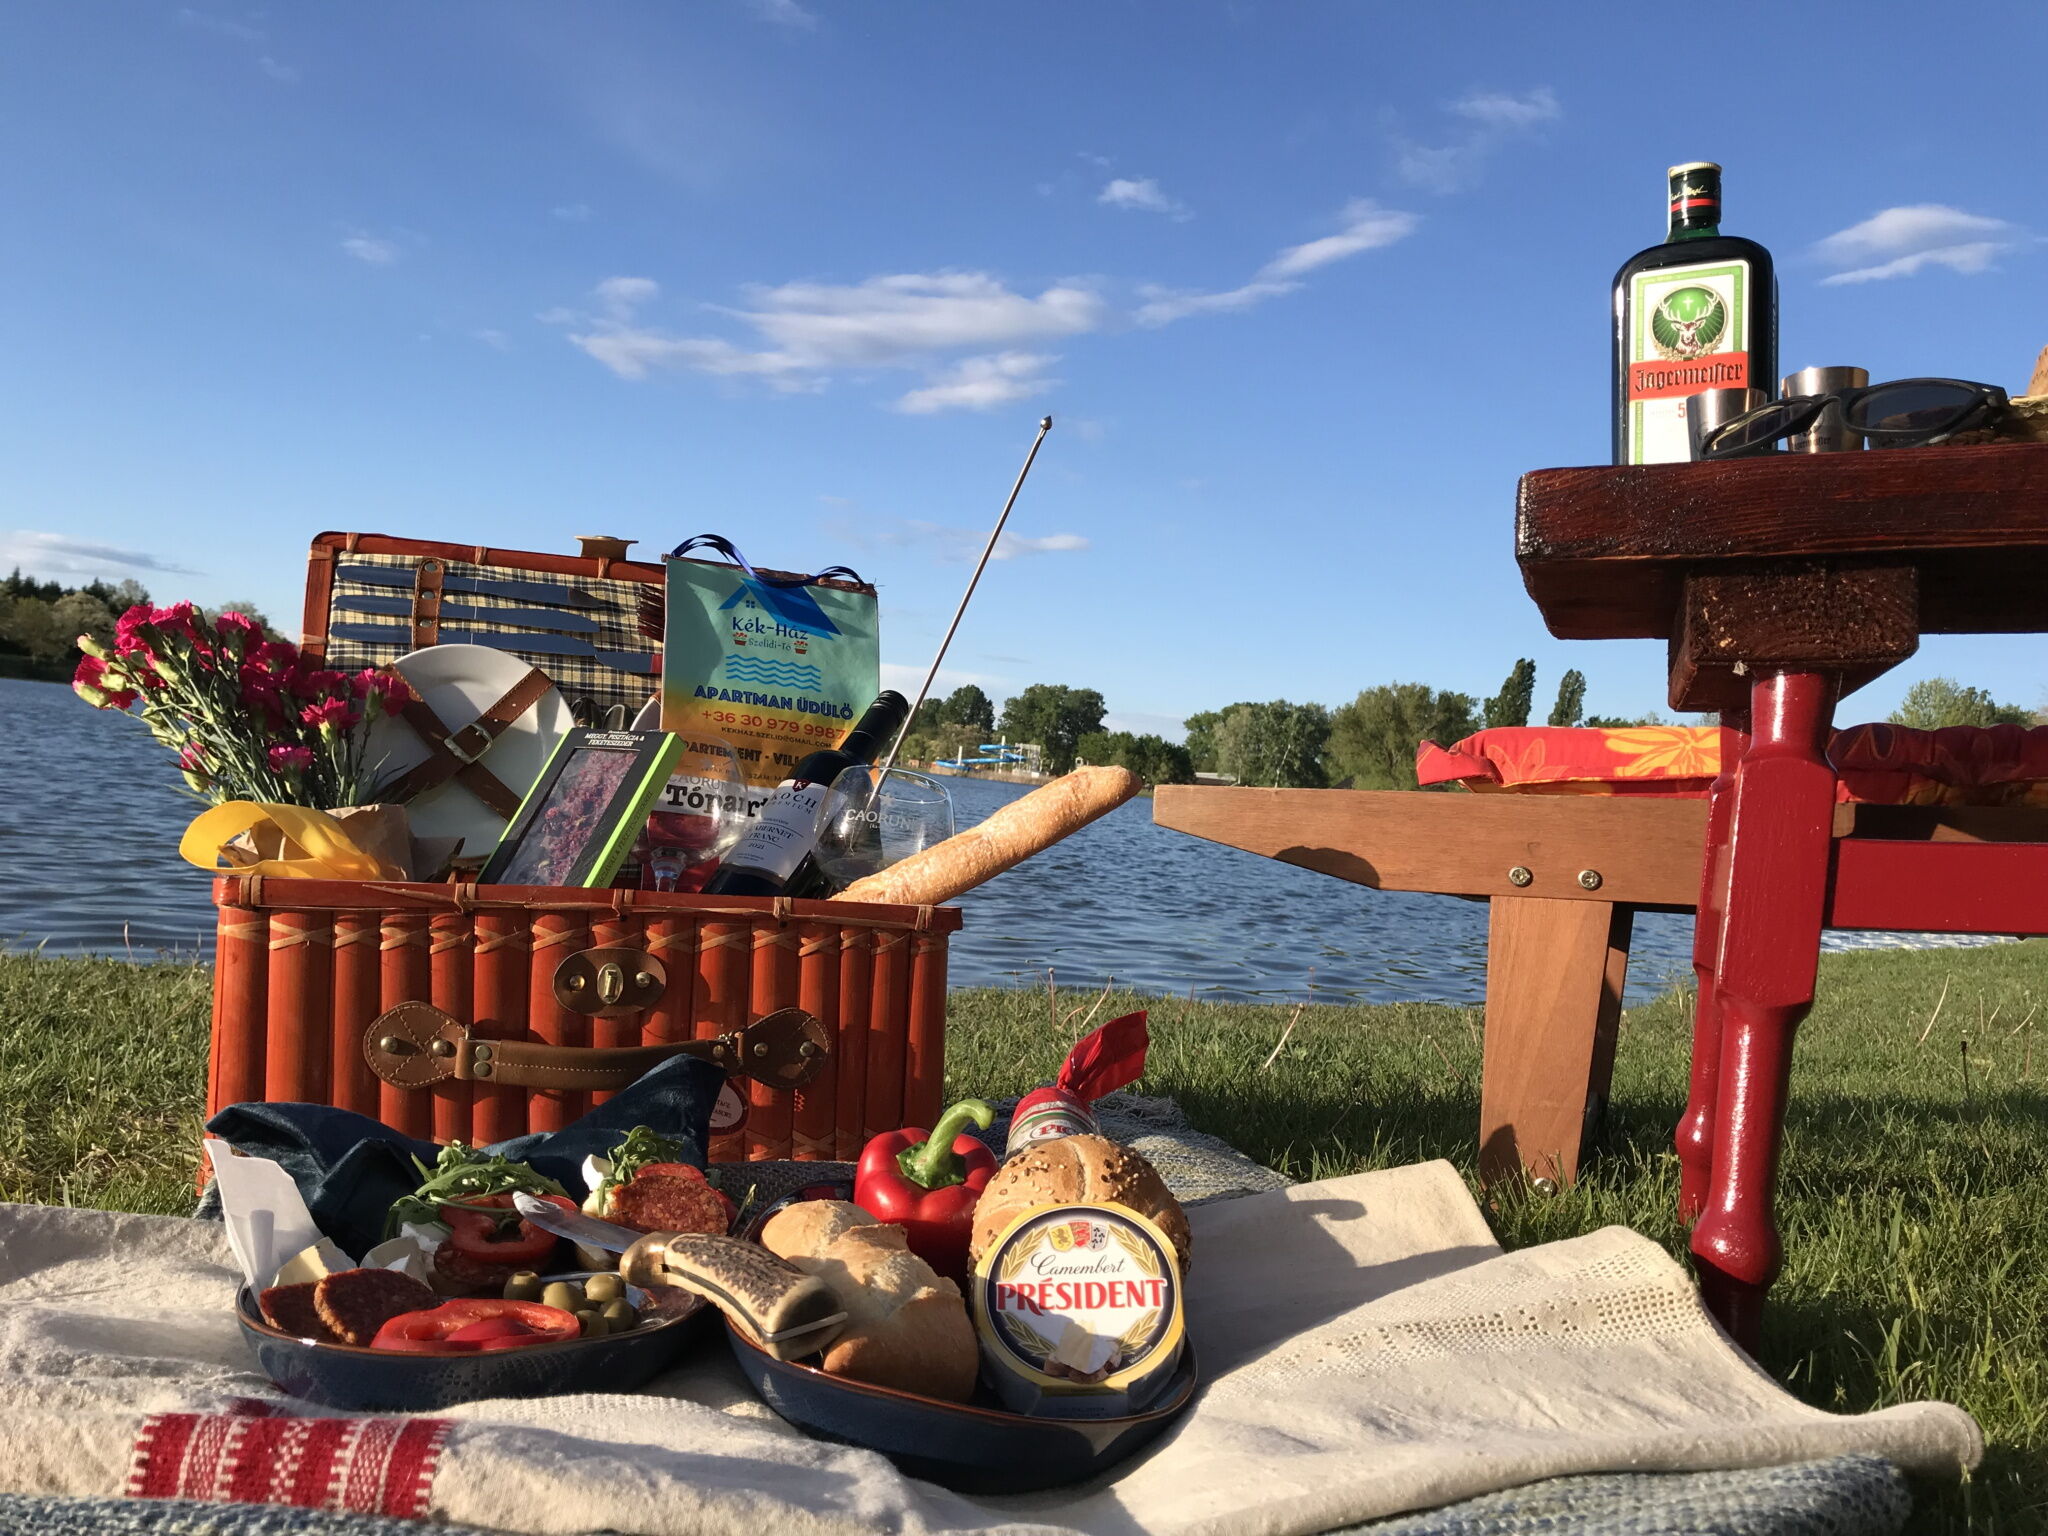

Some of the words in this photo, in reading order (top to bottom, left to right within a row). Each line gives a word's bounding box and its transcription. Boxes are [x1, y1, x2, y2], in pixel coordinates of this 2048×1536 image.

[732, 616, 809, 640] Kék-Ház
[694, 685, 793, 711] APARTMAN
[702, 710, 736, 724] +36
[740, 714, 763, 727] 30
[767, 718, 800, 734] 979
[804, 723, 846, 740] 9987
[1030, 1251, 1126, 1276] Camembert
[996, 1277, 1166, 1317] PRÉSIDENT
